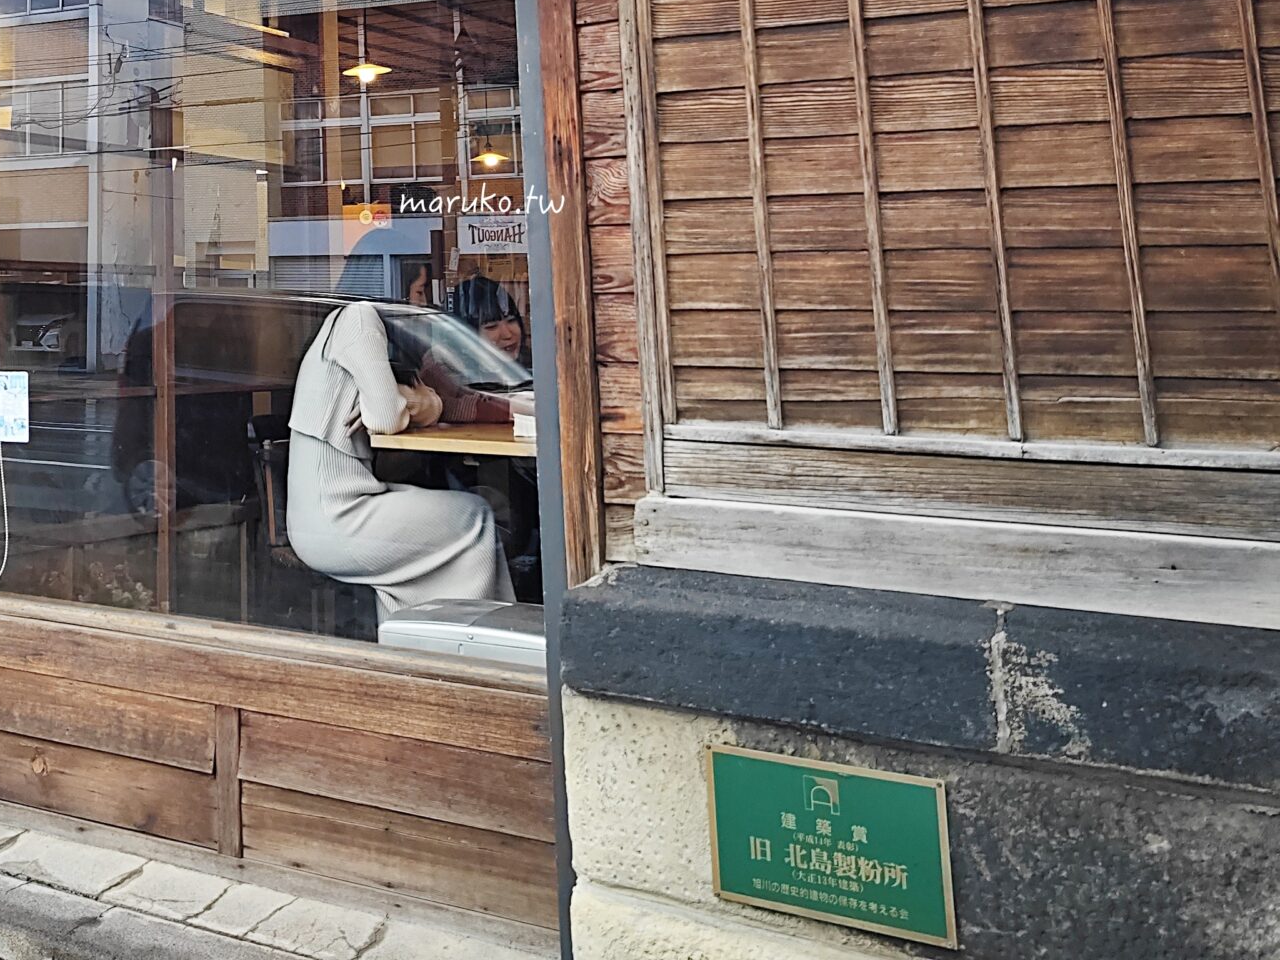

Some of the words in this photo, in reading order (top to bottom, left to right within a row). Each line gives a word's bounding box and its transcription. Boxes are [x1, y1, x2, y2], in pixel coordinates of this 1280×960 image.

[749, 835, 772, 862] 旧
[783, 843, 908, 890] 北島製粉所
